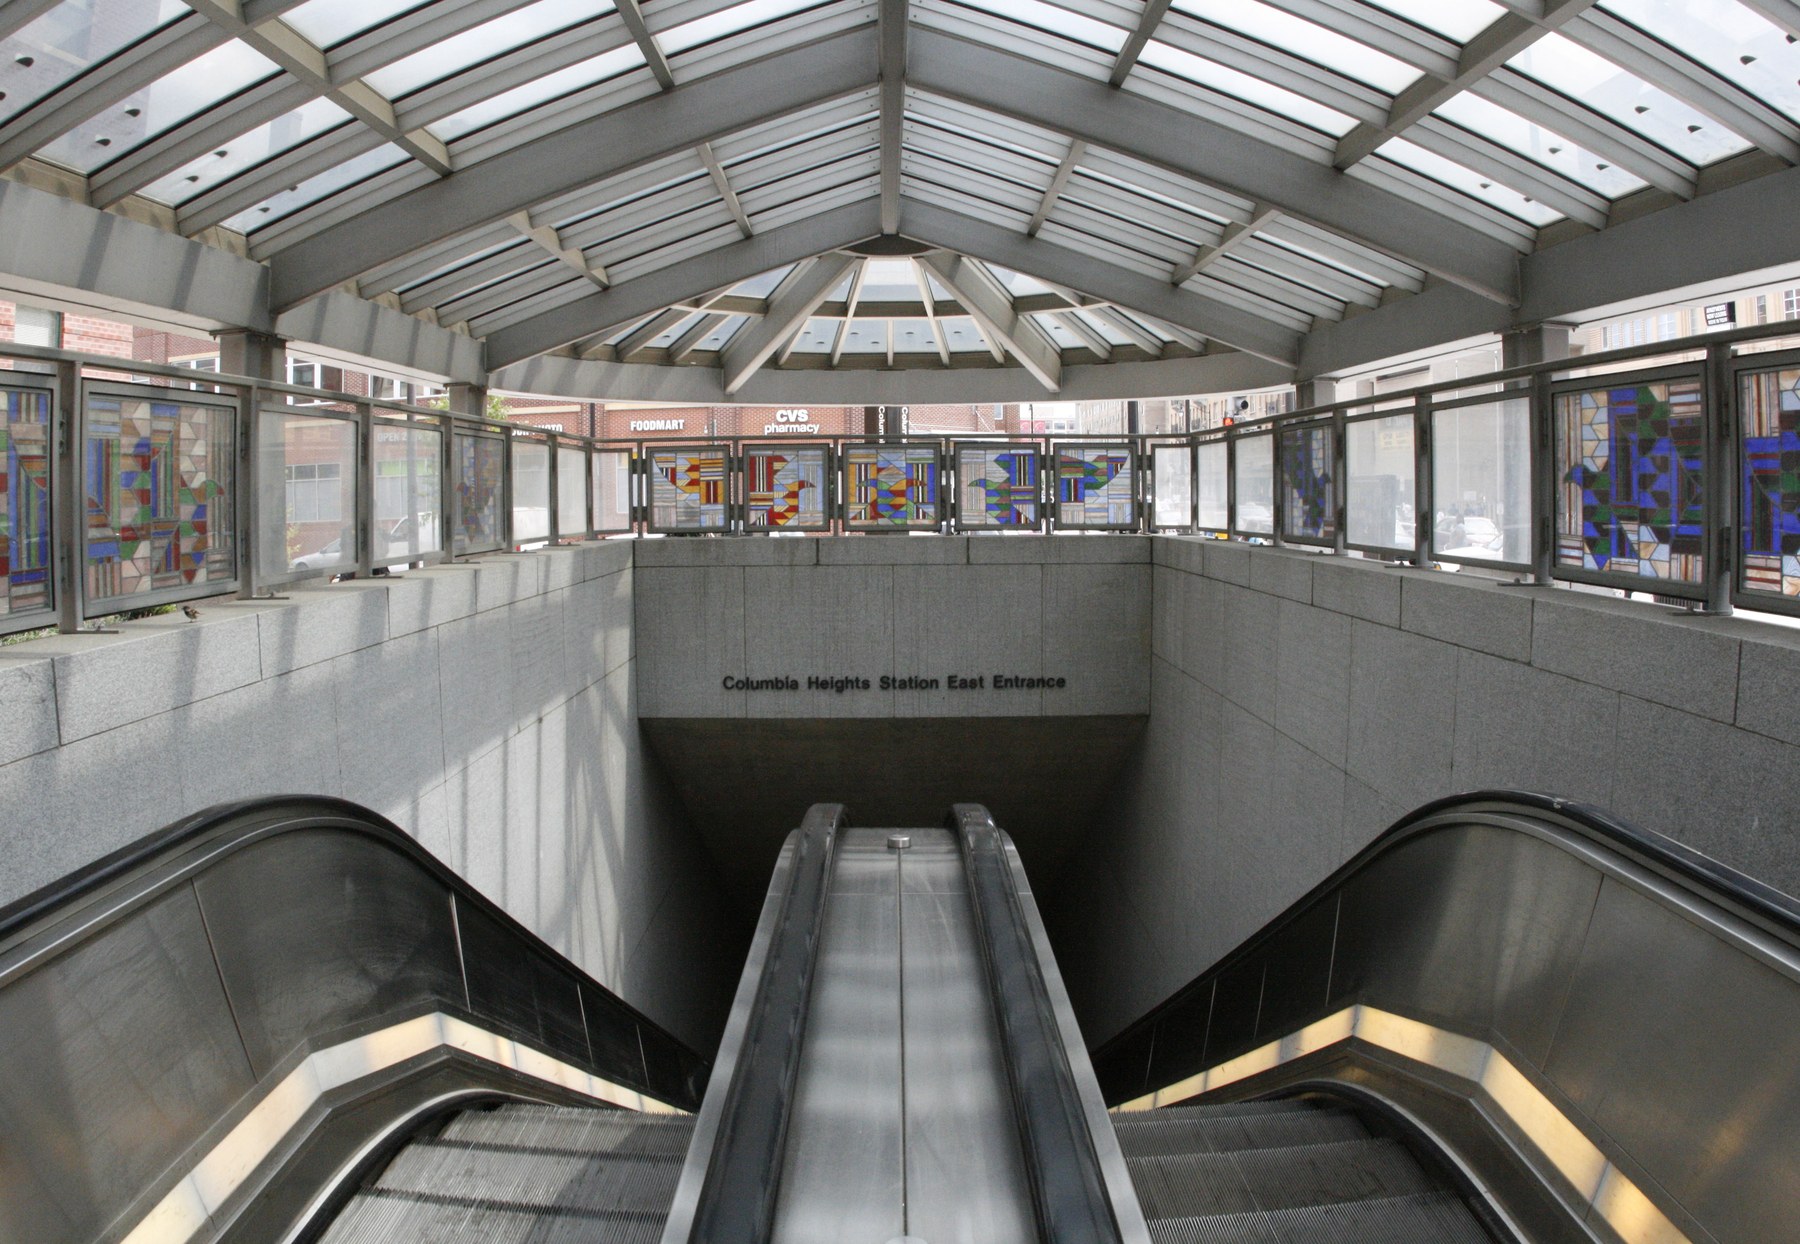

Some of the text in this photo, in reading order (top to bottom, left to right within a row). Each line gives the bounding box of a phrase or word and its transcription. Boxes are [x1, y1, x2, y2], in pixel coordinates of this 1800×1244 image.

[776, 409, 809, 423] CVS
[630, 419, 685, 432] FOODMART
[764, 422, 820, 436] pharmacy
[377, 431, 400, 442] OPEN
[722, 674, 1066, 694] Columbia Heights Station East Entrance
